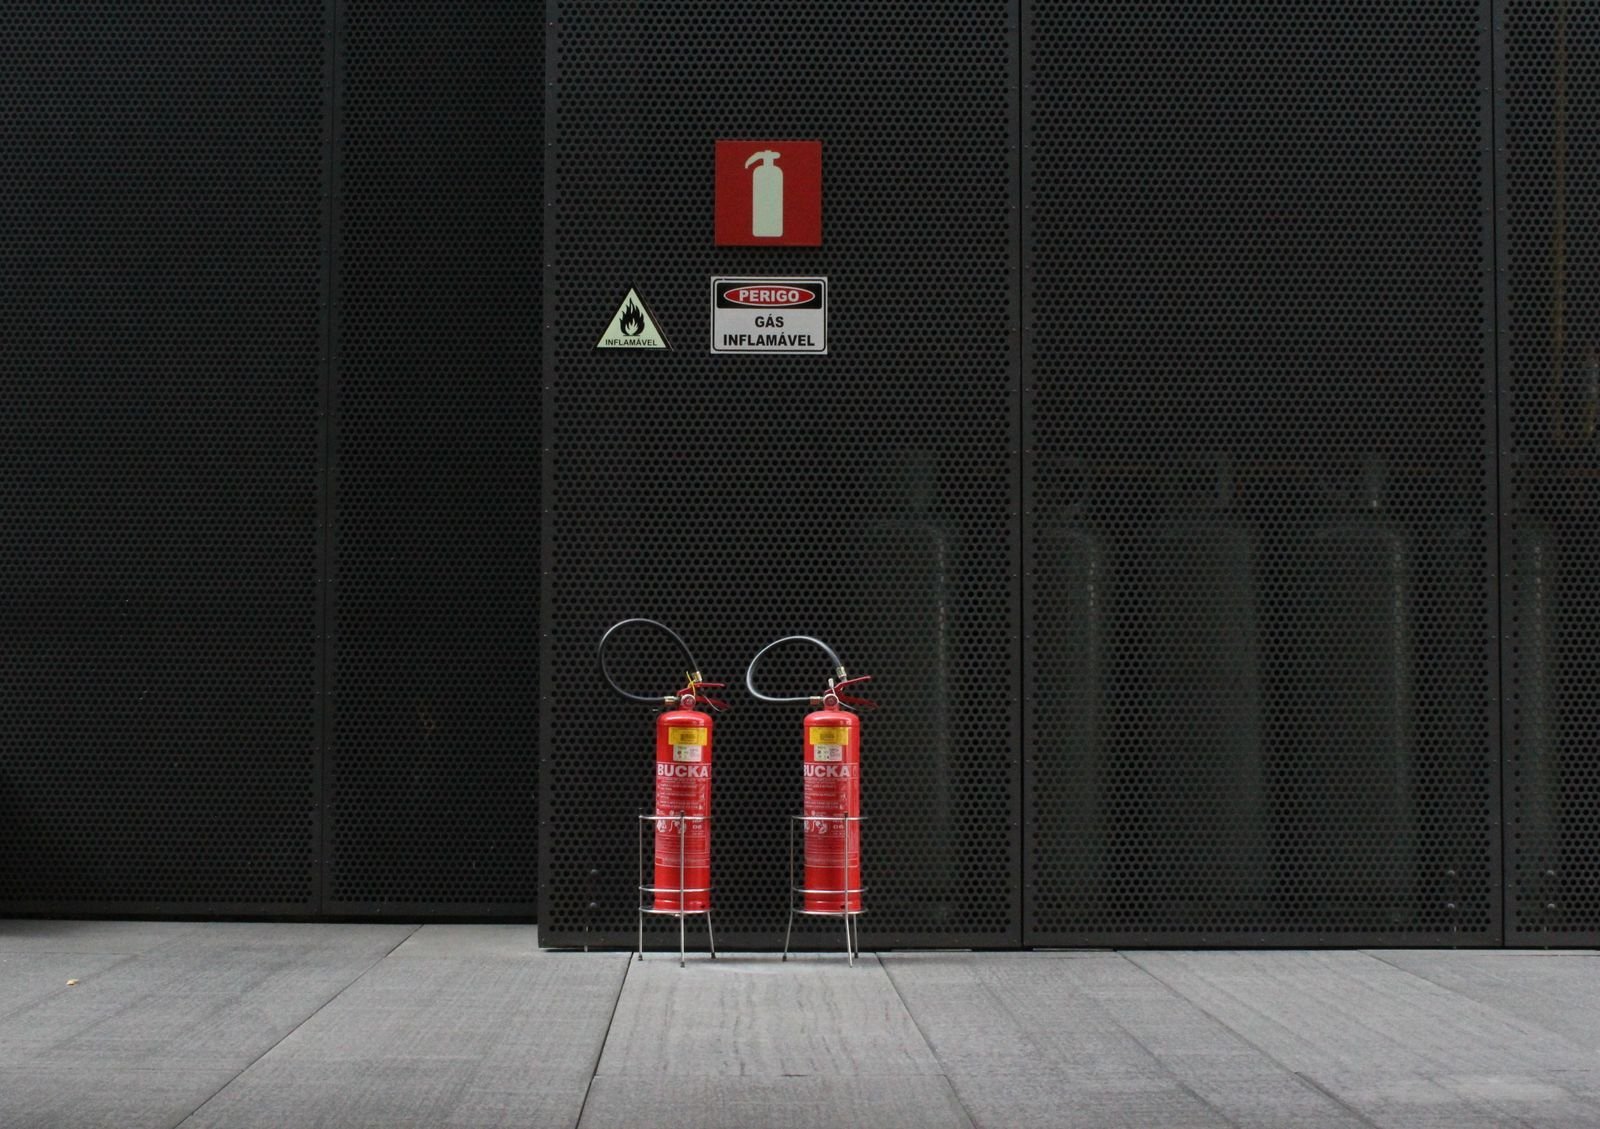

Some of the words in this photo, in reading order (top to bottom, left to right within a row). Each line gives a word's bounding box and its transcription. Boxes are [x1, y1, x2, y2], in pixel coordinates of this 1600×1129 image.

[739, 290, 800, 302] PERIGO
[755, 313, 784, 328] GÁS
[605, 337, 657, 346] INFLAMÁVEL
[723, 331, 815, 346] INFLAMÁVEL
[657, 764, 709, 778] BUCKA
